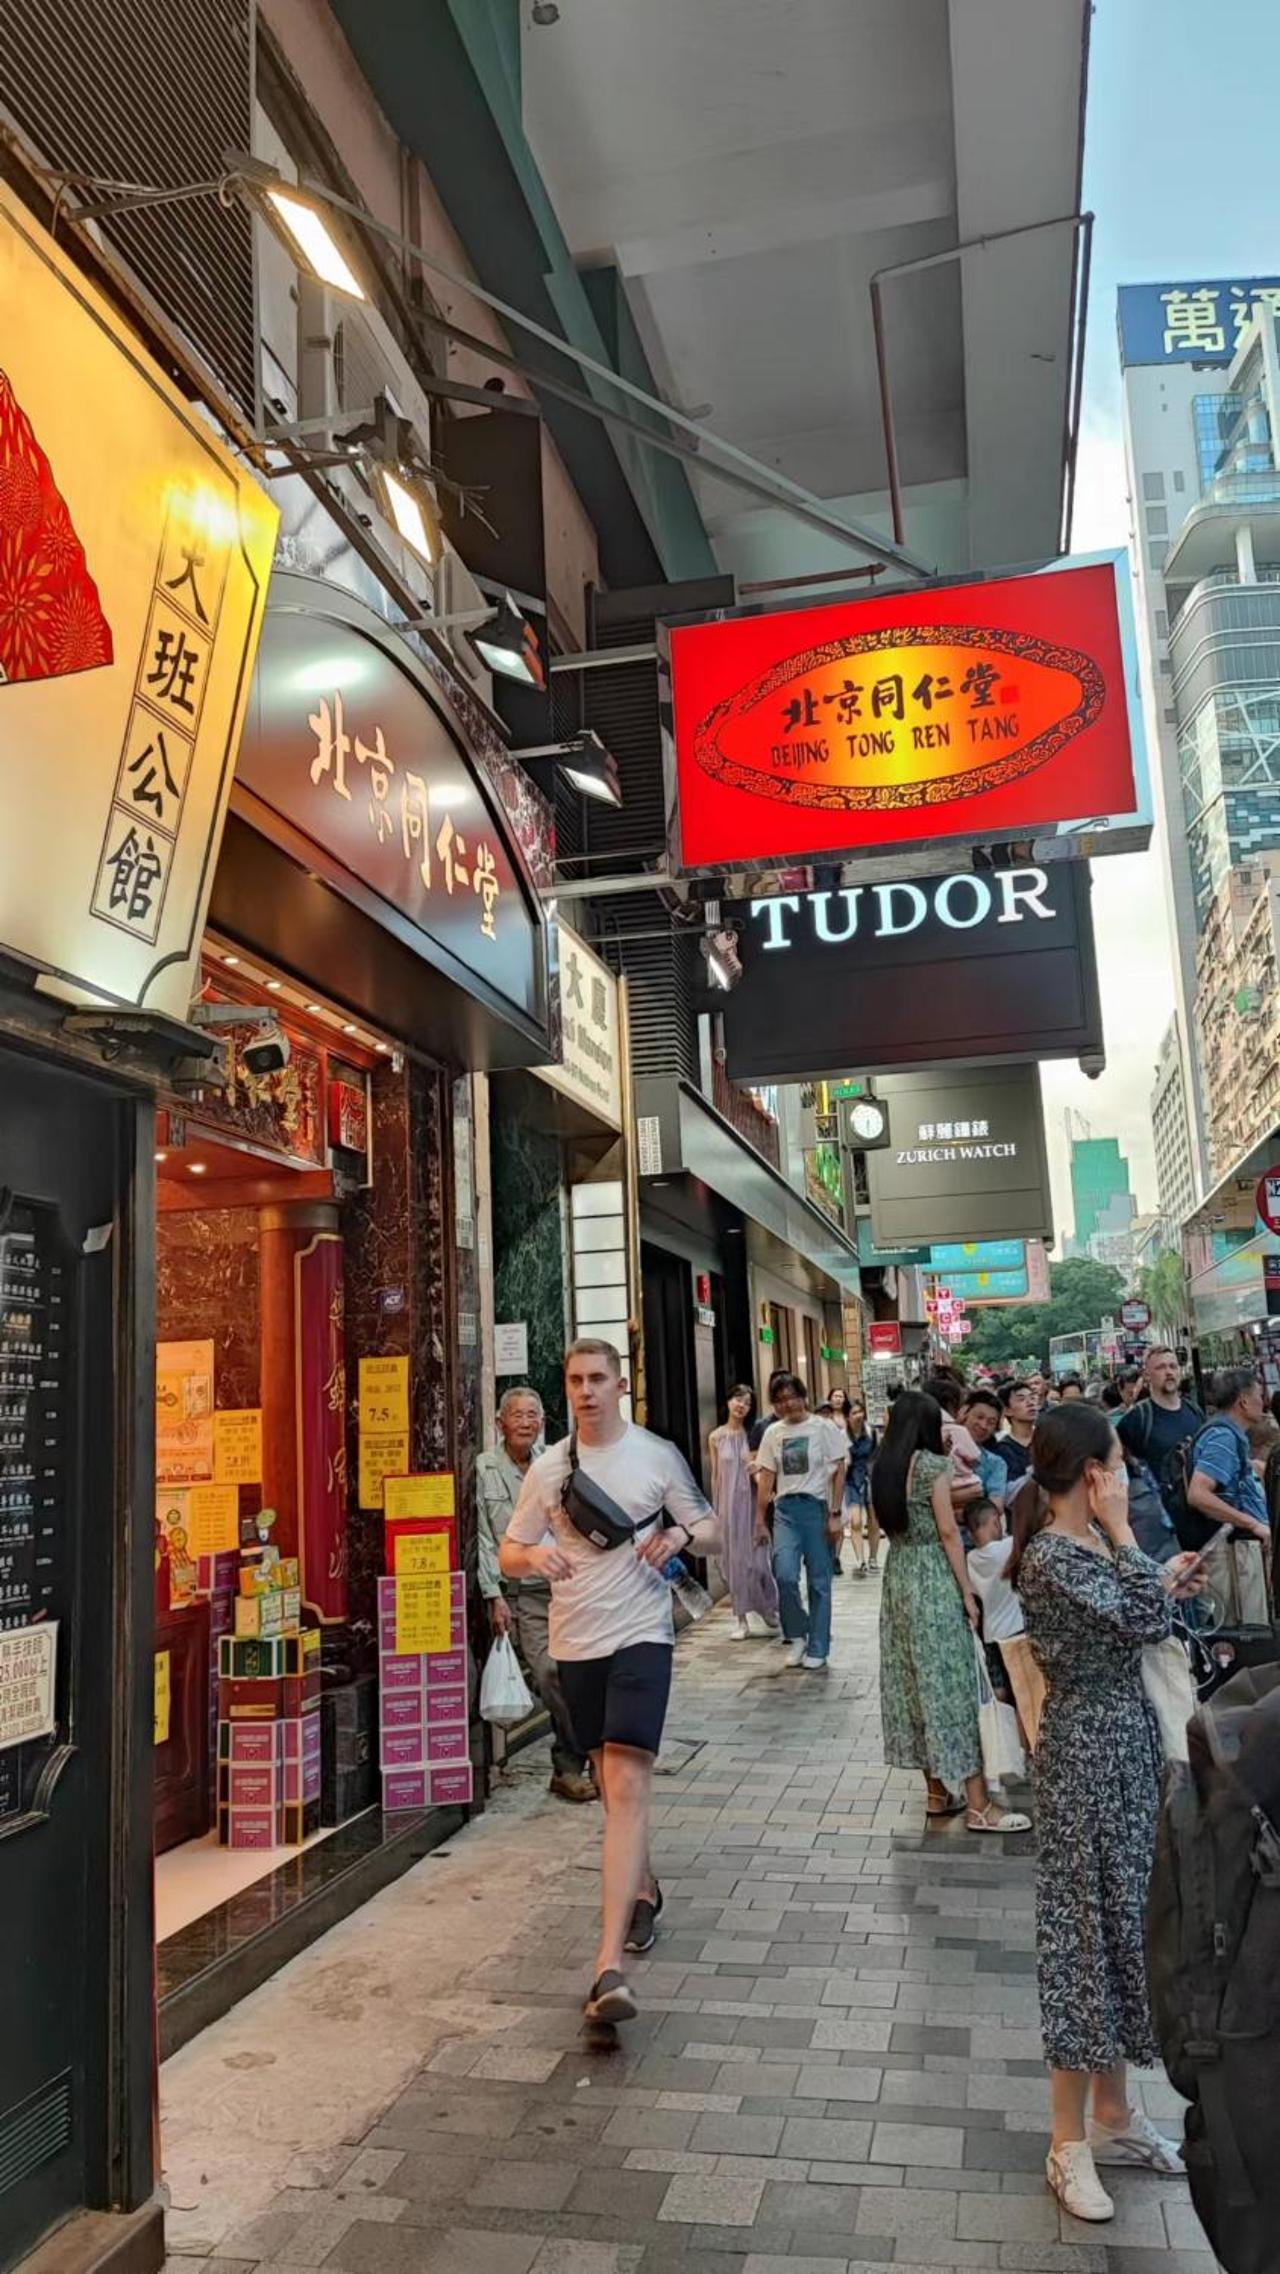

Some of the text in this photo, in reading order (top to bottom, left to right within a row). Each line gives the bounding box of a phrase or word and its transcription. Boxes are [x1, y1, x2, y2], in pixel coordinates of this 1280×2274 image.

[106, 545, 209, 922] 大班公館
[780, 661, 1001, 735] 北京同仁堂
[770, 713, 1020, 770] BEIJING TONG REN TANG
[307, 689, 502, 942] 北京同仁堂
[750, 866, 1057, 950] TUDOR
[896, 1143, 1016, 1164] ZURICH WATCH
